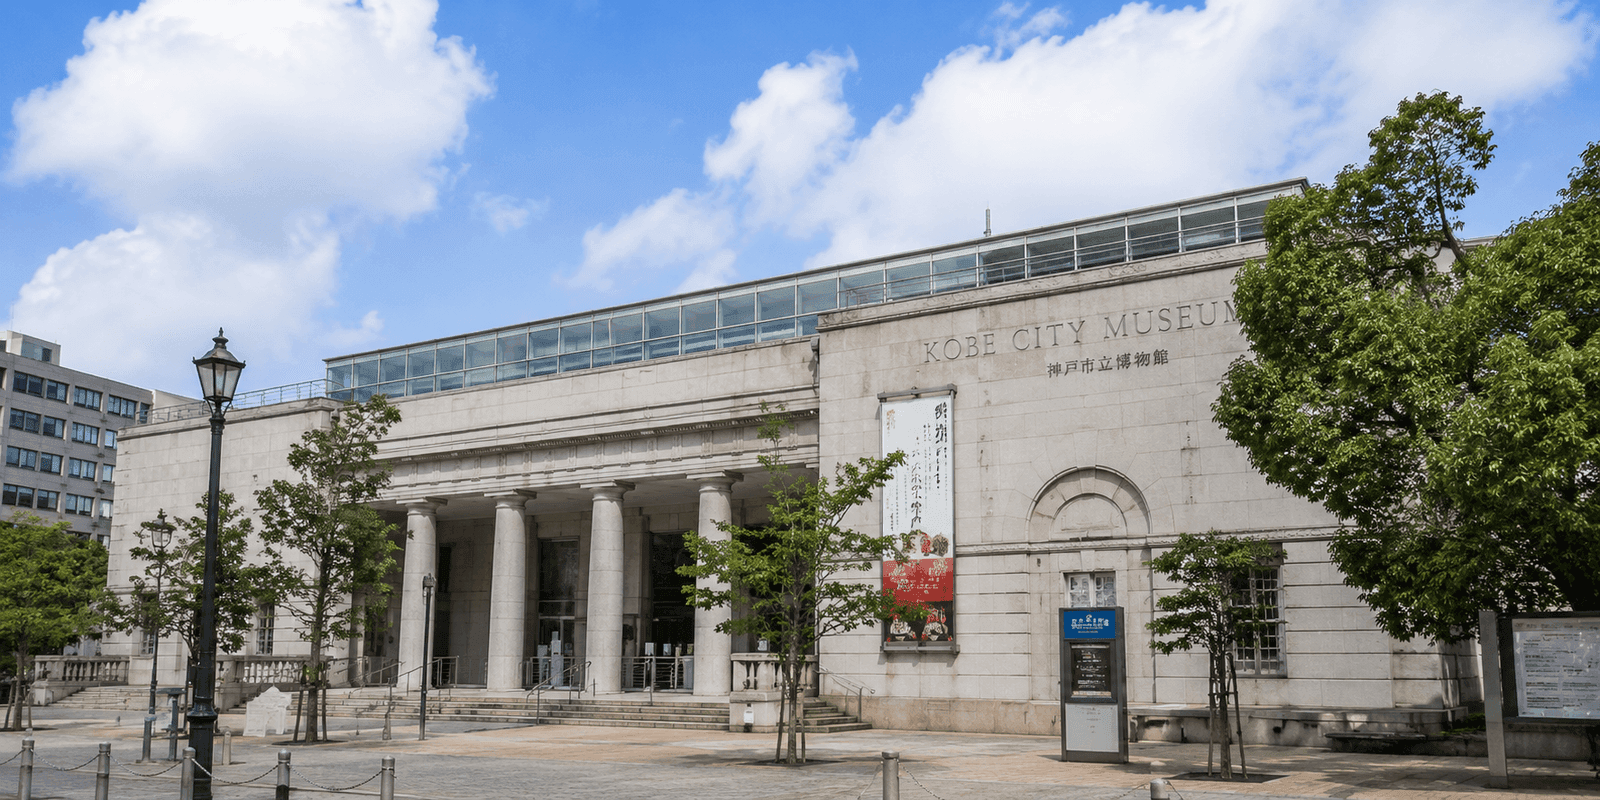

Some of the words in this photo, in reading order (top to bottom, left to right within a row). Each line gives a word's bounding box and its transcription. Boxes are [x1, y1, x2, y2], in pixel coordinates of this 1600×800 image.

[924, 333, 996, 363] KOBE
[1012, 320, 1086, 351] CITY
[1047, 349, 1169, 378] 神戸市立博物館
